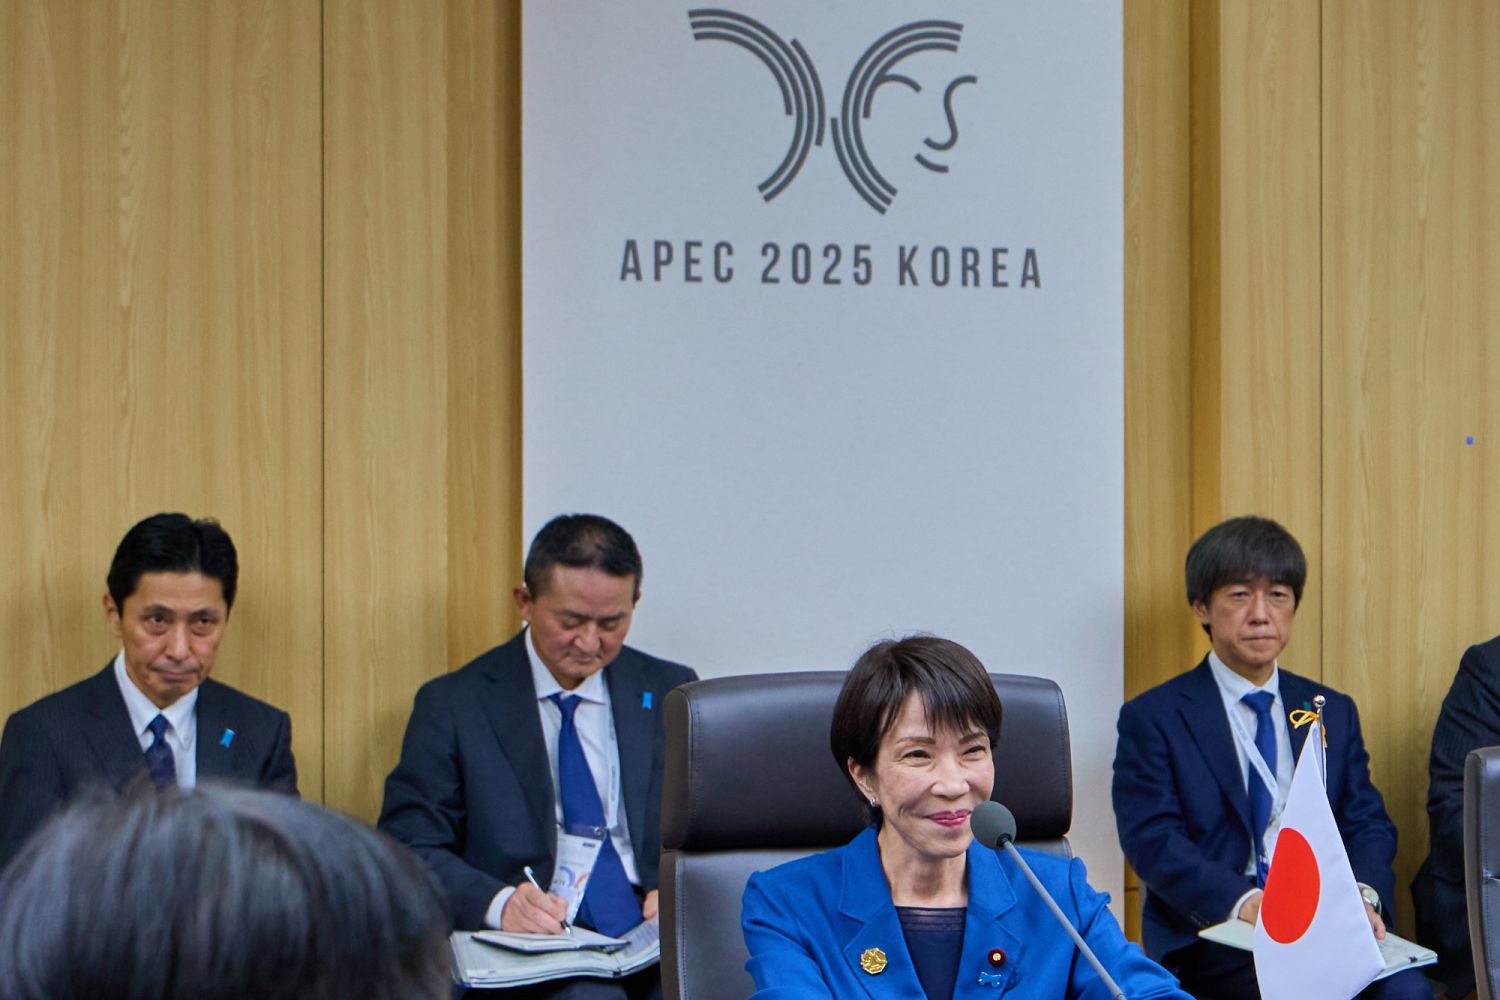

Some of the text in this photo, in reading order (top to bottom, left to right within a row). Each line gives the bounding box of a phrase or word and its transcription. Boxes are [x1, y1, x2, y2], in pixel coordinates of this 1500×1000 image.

[619, 240, 1041, 288] APEC 2025 KOREA
